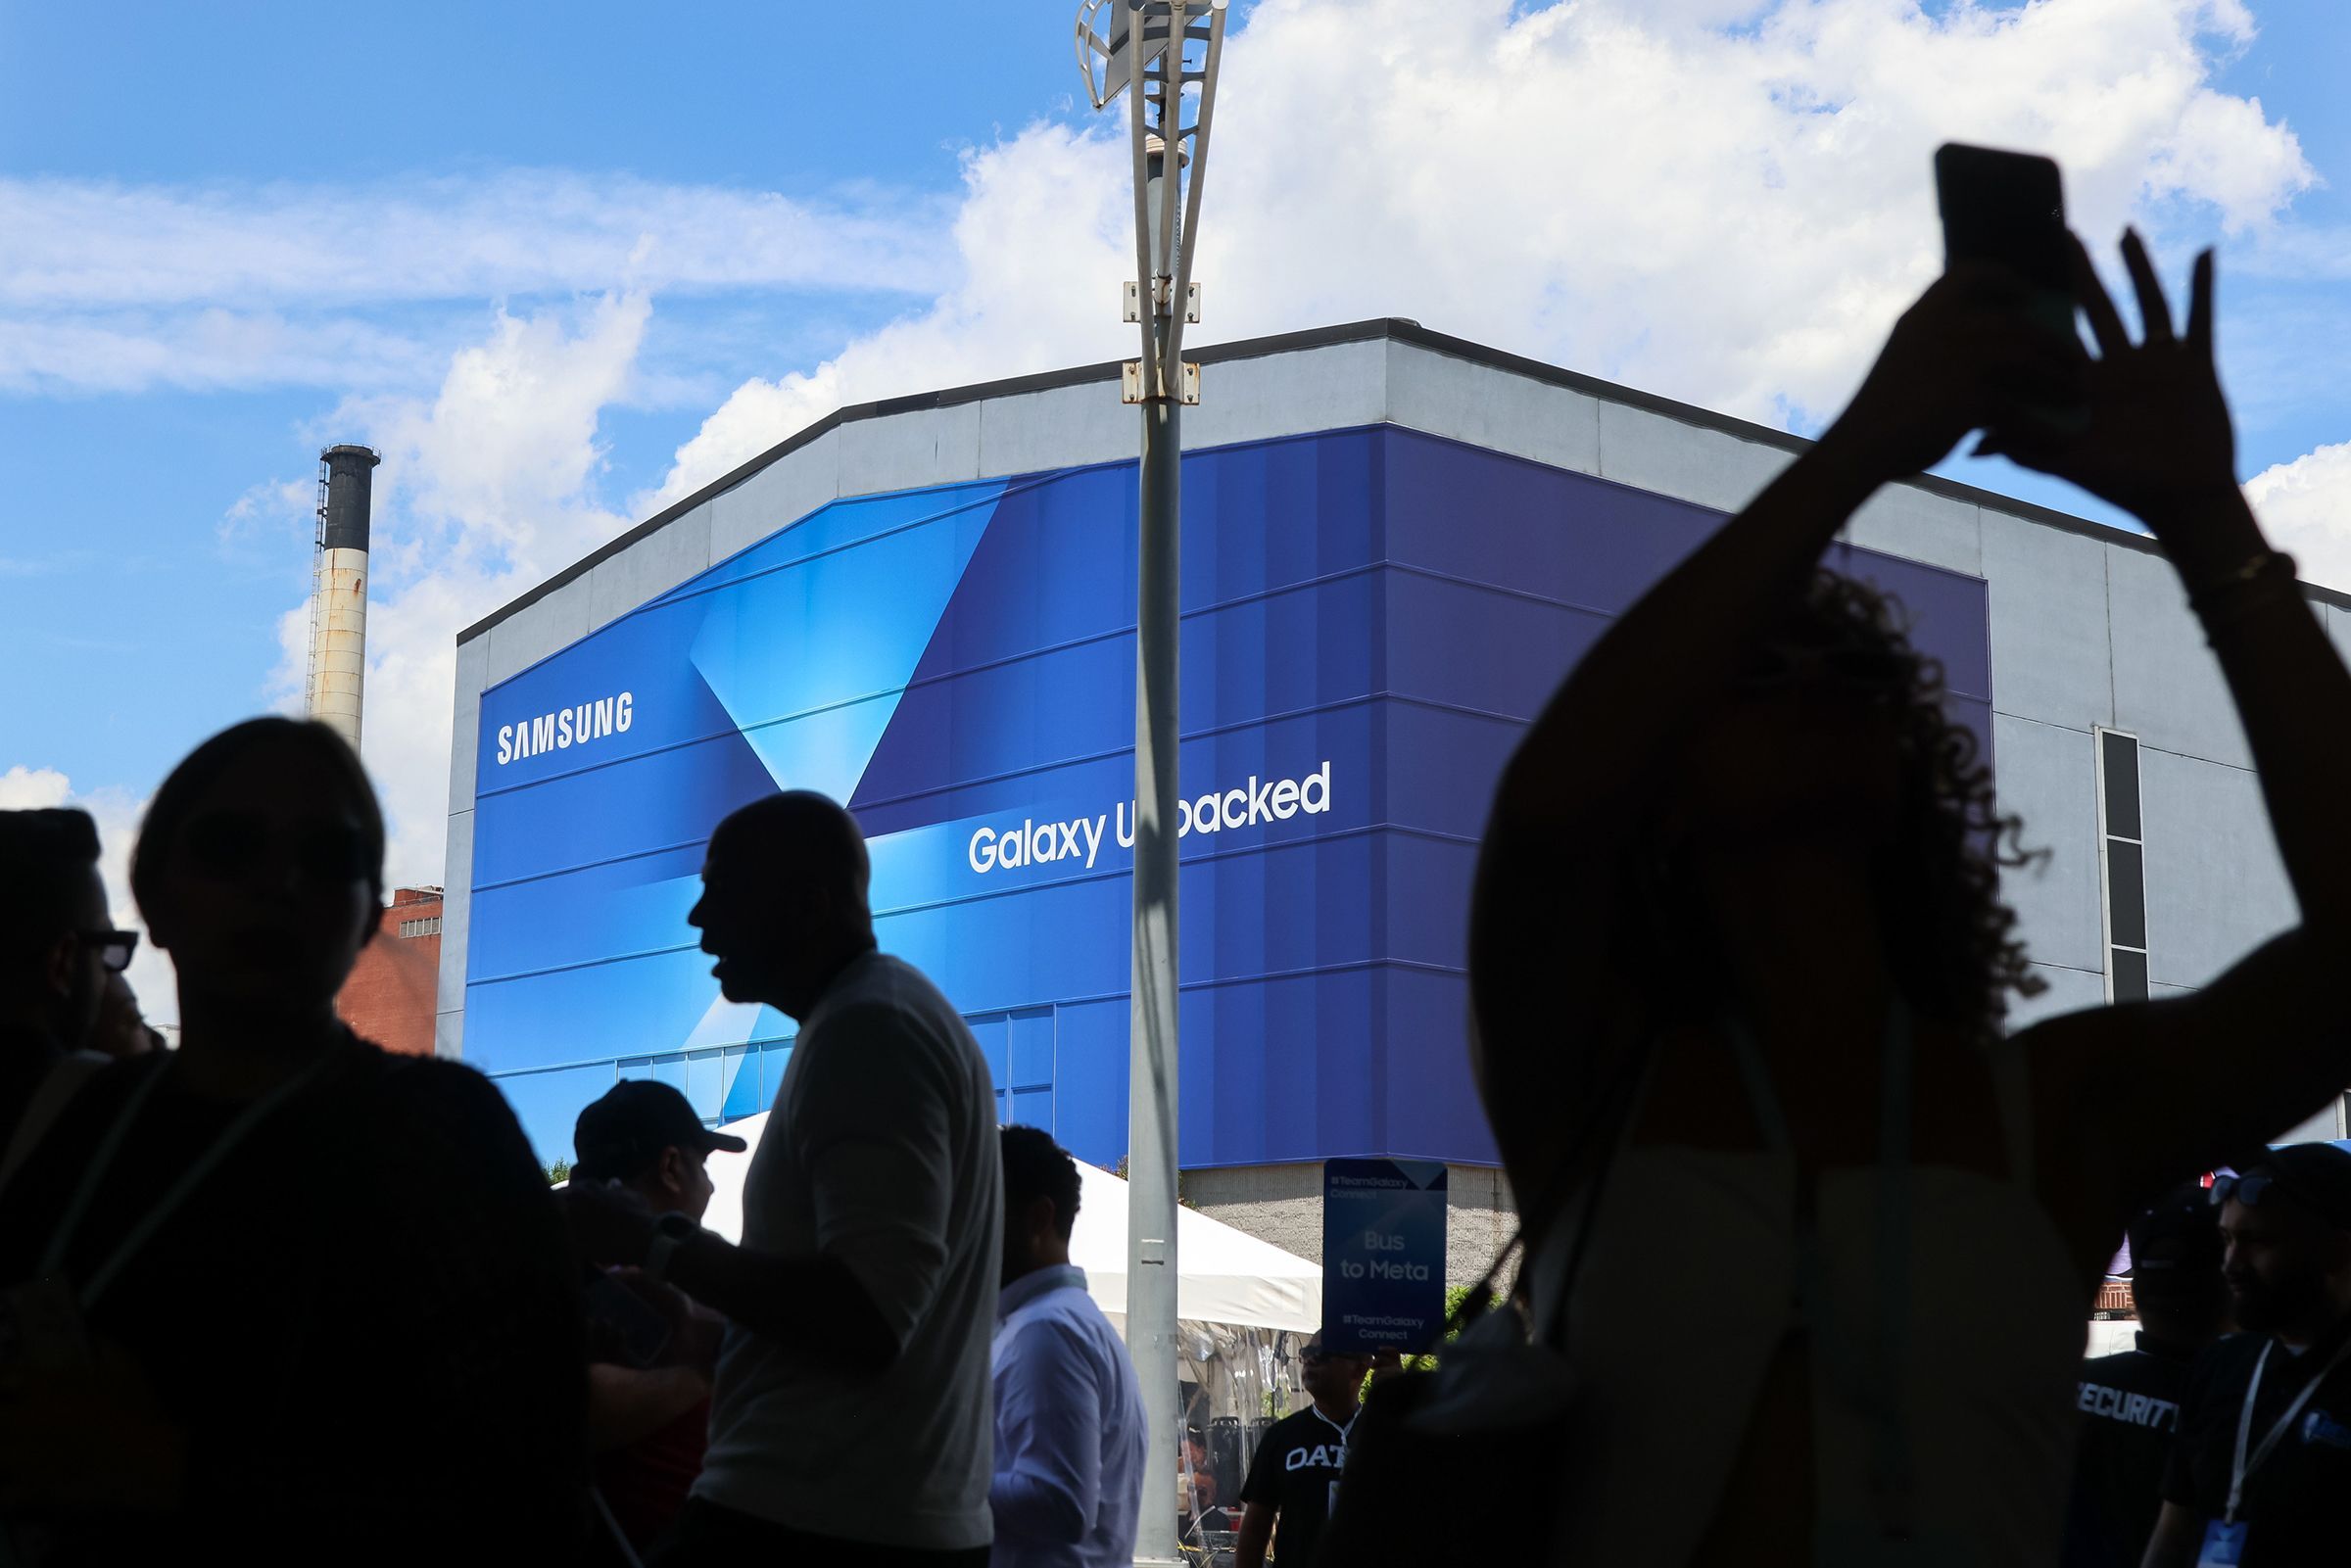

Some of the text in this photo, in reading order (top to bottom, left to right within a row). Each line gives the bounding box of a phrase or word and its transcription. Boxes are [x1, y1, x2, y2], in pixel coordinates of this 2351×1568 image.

[497, 691, 633, 765] SAMSUNG
[968, 761, 1331, 874] Galaxy Uacked
[1330, 1175, 1410, 1190] #TeamGalaxy
[1330, 1189, 1377, 1200] Connect
[1364, 1230, 1406, 1251] Bus
[1340, 1259, 1429, 1282] to Meta
[1342, 1314, 1425, 1329] #TeamGalaxy
[1358, 1328, 1409, 1340] Connect
[2077, 1381, 2181, 1433] ECURIT
